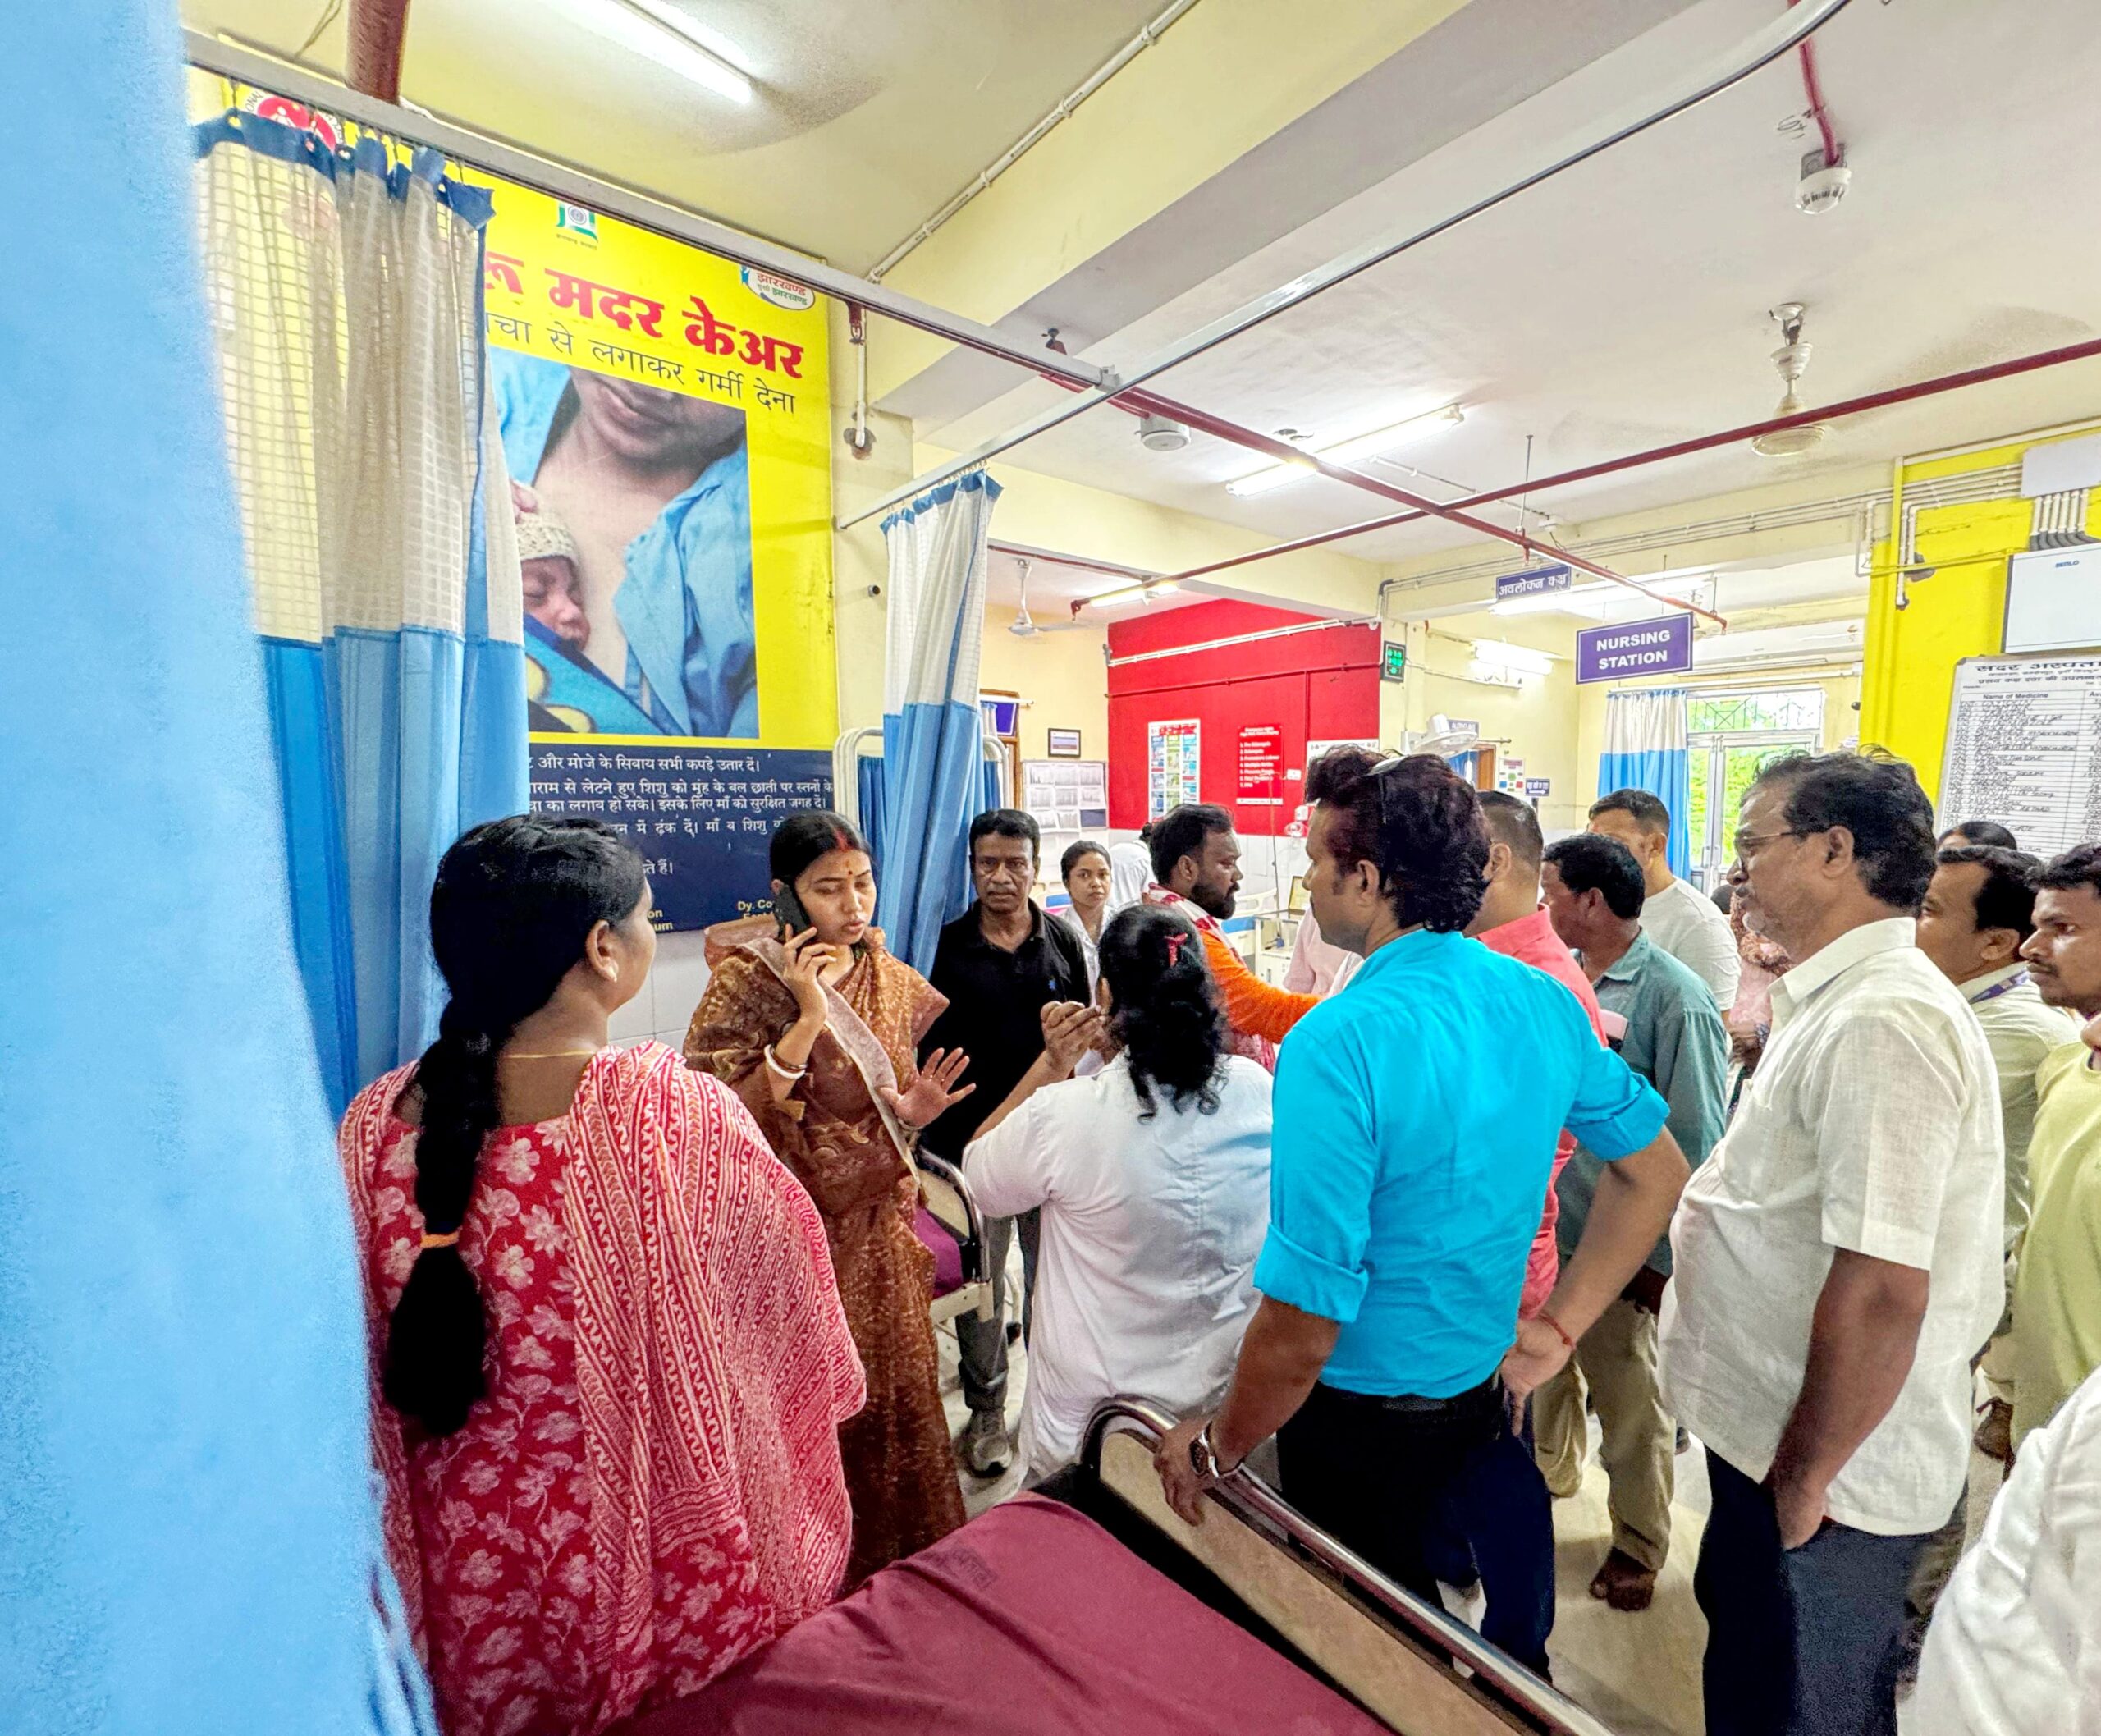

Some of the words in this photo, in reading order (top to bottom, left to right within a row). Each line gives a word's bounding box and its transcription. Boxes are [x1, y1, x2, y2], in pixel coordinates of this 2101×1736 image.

[485, 250, 524, 295] रू
[544, 268, 666, 338] मदर
[682, 295, 805, 379] केअर
[547, 320, 574, 355] से
[588, 339, 684, 385] लगाकर
[696, 369, 744, 400] गर्मी
[753, 377, 796, 414] देना
[1499, 577, 1545, 596] अवलोकन
[1596, 630, 1671, 652] NURSING
[1599, 649, 1668, 670] STATION
[1975, 663, 2022, 672] सदर
[538, 751, 565, 769] और
[566, 752, 596, 770] मोजे
[598, 753, 613, 770] के
[616, 753, 655, 770] सिवाय
[657, 755, 683, 771] सभी
[686, 756, 715, 773] कपड़े
[717, 759, 744, 772] उतार
[564, 777, 577, 795] से
[581, 777, 613, 795] लेटने
[617, 781, 637, 799] हुए
[639, 778, 670, 799] शिशु
[671, 778, 687, 794] को
[692, 778, 709, 797] मुंह
[713, 778, 726, 794] के
[728, 782, 747, 794] बल
[751, 779, 777, 794] छाती
[780, 782, 794, 794] पर
[796, 778, 821, 793] स्तनों
[823, 779, 833, 794] के
[545, 800, 565, 812] का
[568, 799, 605, 812] लगाव
[608, 795, 622, 813] हो
[658, 796, 689, 813] इसके
[691, 796, 714, 813] लिए
[716, 795, 730, 810] माँ
[732, 795, 748, 810] को
[750, 795, 786, 814] सुरक्षित
[789, 798, 812, 809] जगह
[635, 819, 648, 835] में
[705, 817, 721, 832] माँ
[726, 821, 736, 831] व
[742, 816, 768, 836] शिशु
[737, 900, 755, 912] Dy.
[758, 899, 775, 909] Co
